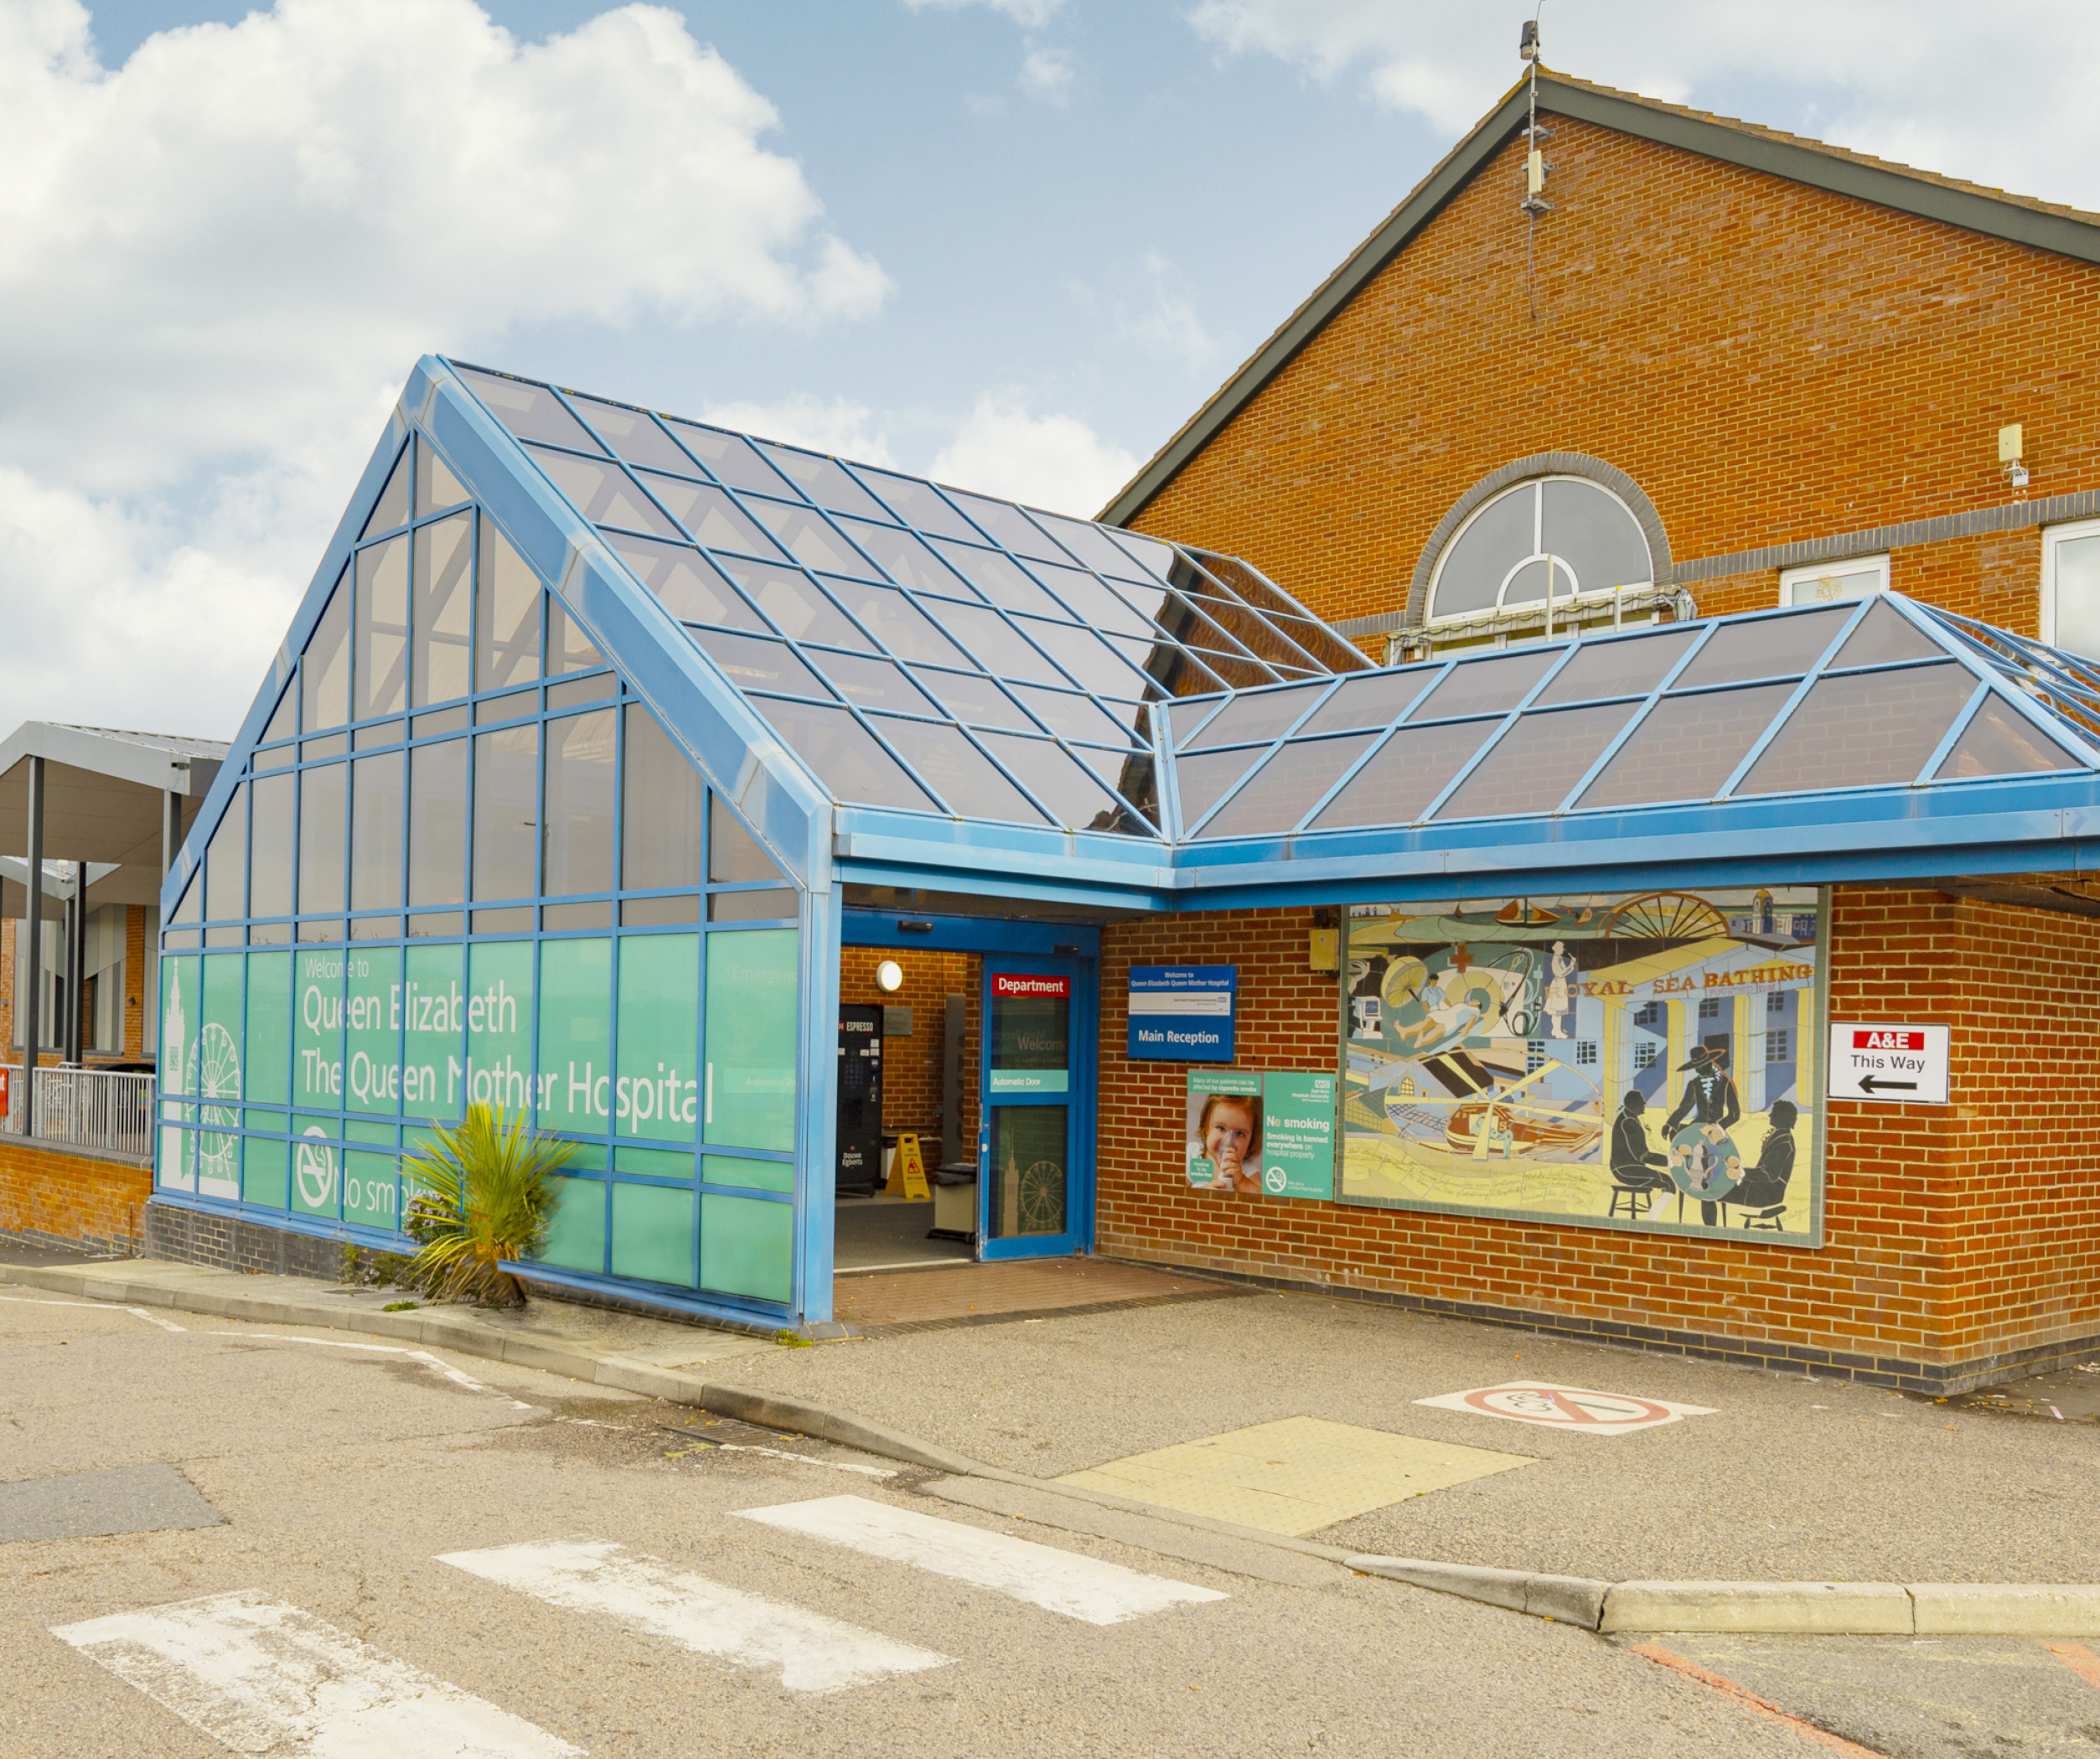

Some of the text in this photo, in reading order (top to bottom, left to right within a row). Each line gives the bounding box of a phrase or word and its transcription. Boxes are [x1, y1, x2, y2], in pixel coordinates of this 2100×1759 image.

[358, 958, 369, 978] to
[998, 977, 1064, 994] Department
[1544, 965, 1812, 1000] ROYAL SEA BATHING
[303, 980, 516, 1036] Queen Elizabeth
[846, 1022, 873, 1032] ESPRESSO
[1138, 1029, 1219, 1046] Main Reception
[1866, 1032, 1909, 1048] A&E
[1850, 1054, 1926, 1074] This Way
[993, 1078, 1042, 1086] Automatic Door
[302, 1048, 713, 1134] The Queen Mother Hospital
[1266, 1115, 1330, 1133] No smoking
[1266, 1132, 1296, 1143] Smoking
[1303, 1135, 1328, 1144] banned
[1266, 1141, 1303, 1150] everywhere
[1266, 1148, 1315, 1160] hospital property
[842, 1159, 863, 1167] Egberts
[334, 1167, 360, 1208] No
